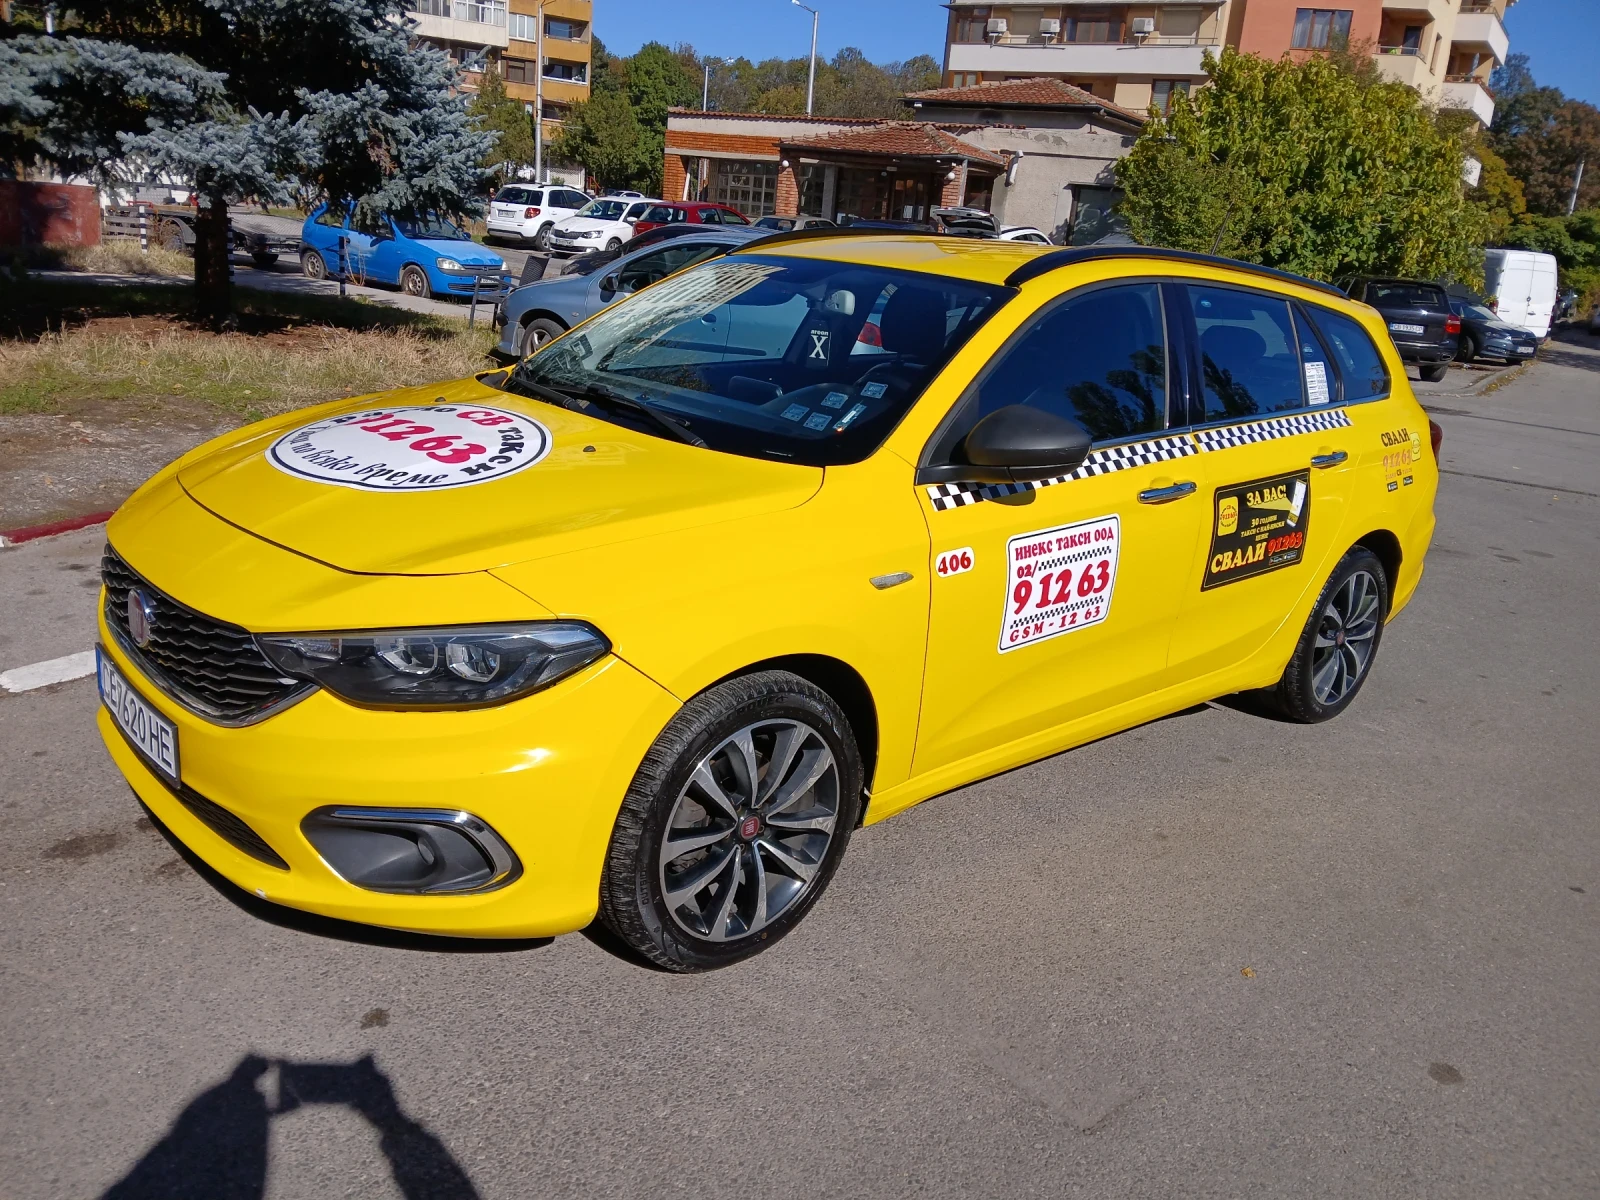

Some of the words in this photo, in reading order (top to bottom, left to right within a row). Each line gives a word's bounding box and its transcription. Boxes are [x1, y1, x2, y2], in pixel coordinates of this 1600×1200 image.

[808, 335, 829, 360] X
[456, 409, 514, 427] СВ
[1380, 427, 1411, 447] СВАЛИ
[459, 427, 525, 476] такси
[302, 449, 360, 471] всяко
[353, 462, 449, 486] време
[1246, 491, 1263, 507] ЗА
[1263, 484, 1287, 503] ВАС!
[937, 551, 972, 575] 406
[1210, 541, 1268, 574] СВАЛИ
[1266, 531, 1303, 557] 91263
[1016, 561, 1039, 579] 02/
[1009, 620, 1045, 643] GSM
